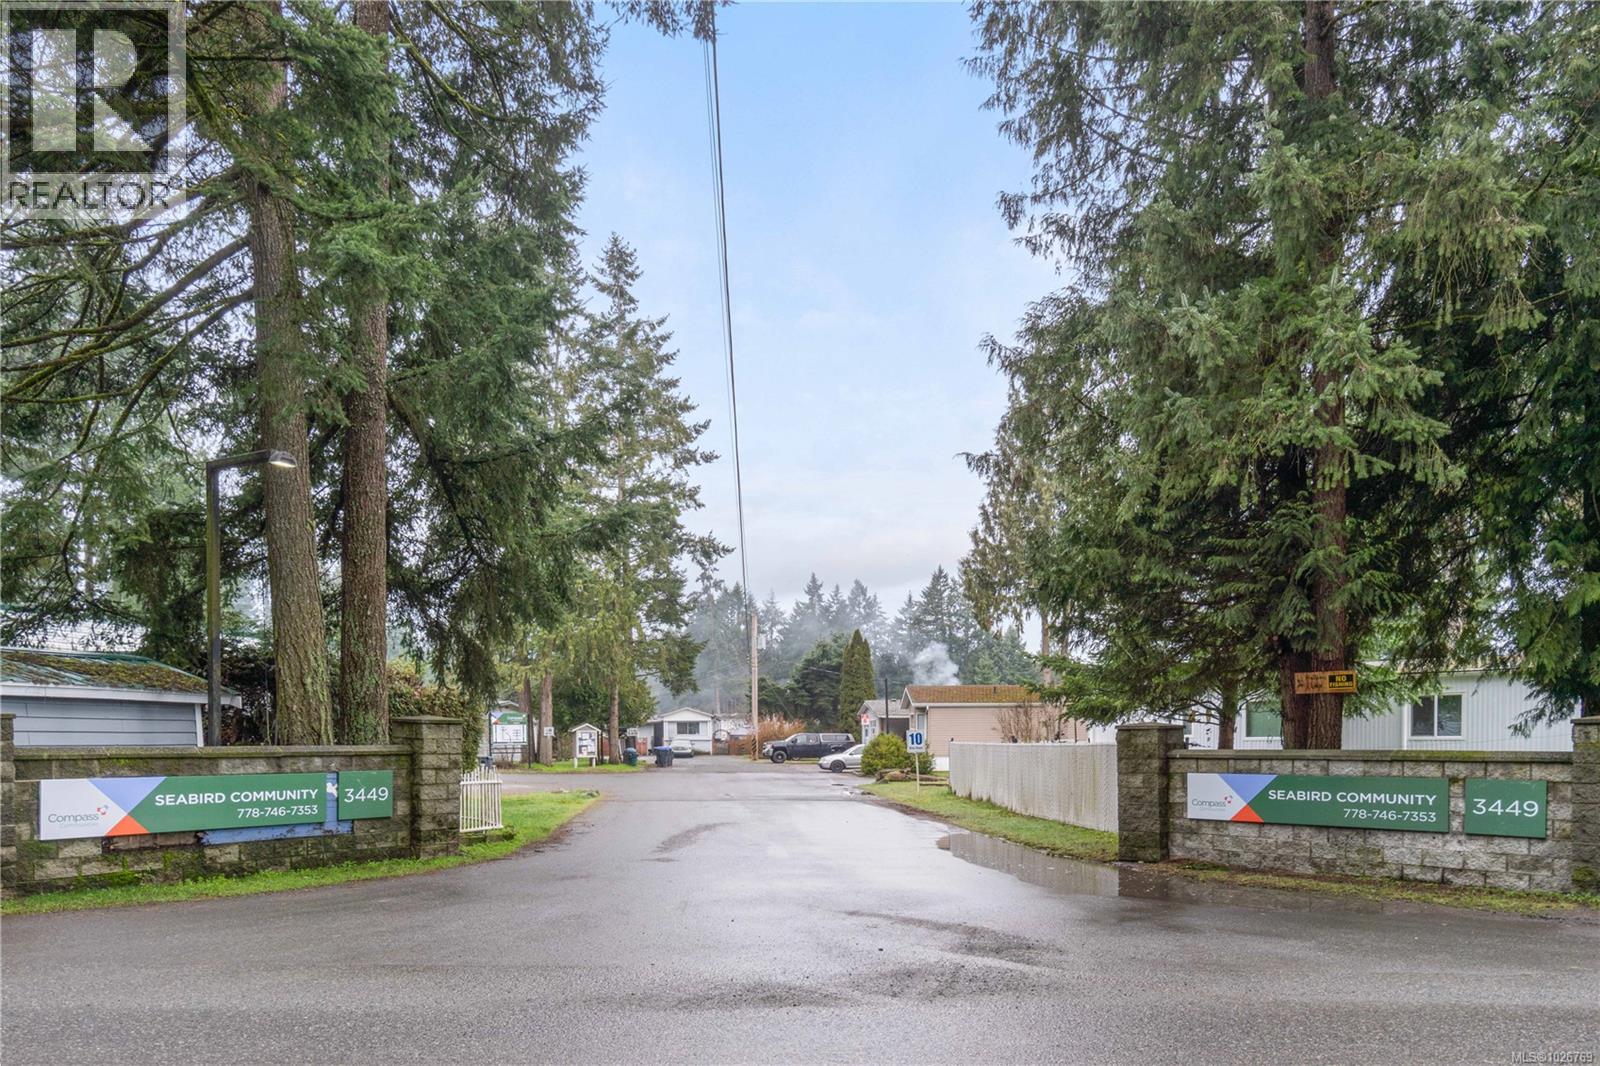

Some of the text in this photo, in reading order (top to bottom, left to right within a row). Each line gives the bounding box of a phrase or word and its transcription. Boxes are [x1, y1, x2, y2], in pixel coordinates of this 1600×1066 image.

[909, 732, 923, 746] 10
[155, 789, 319, 806] SEABIRD COMMUNITY
[343, 786, 389, 803] 3449
[1268, 789, 1437, 806] SEABIRD COMMUNITY
[1191, 798, 1226, 808] Compass
[1472, 798, 1539, 817] 3449
[48, 811, 99, 825] Compass
[236, 805, 319, 819] 778-746-7353
[1343, 808, 1437, 823] 778-746-7353
